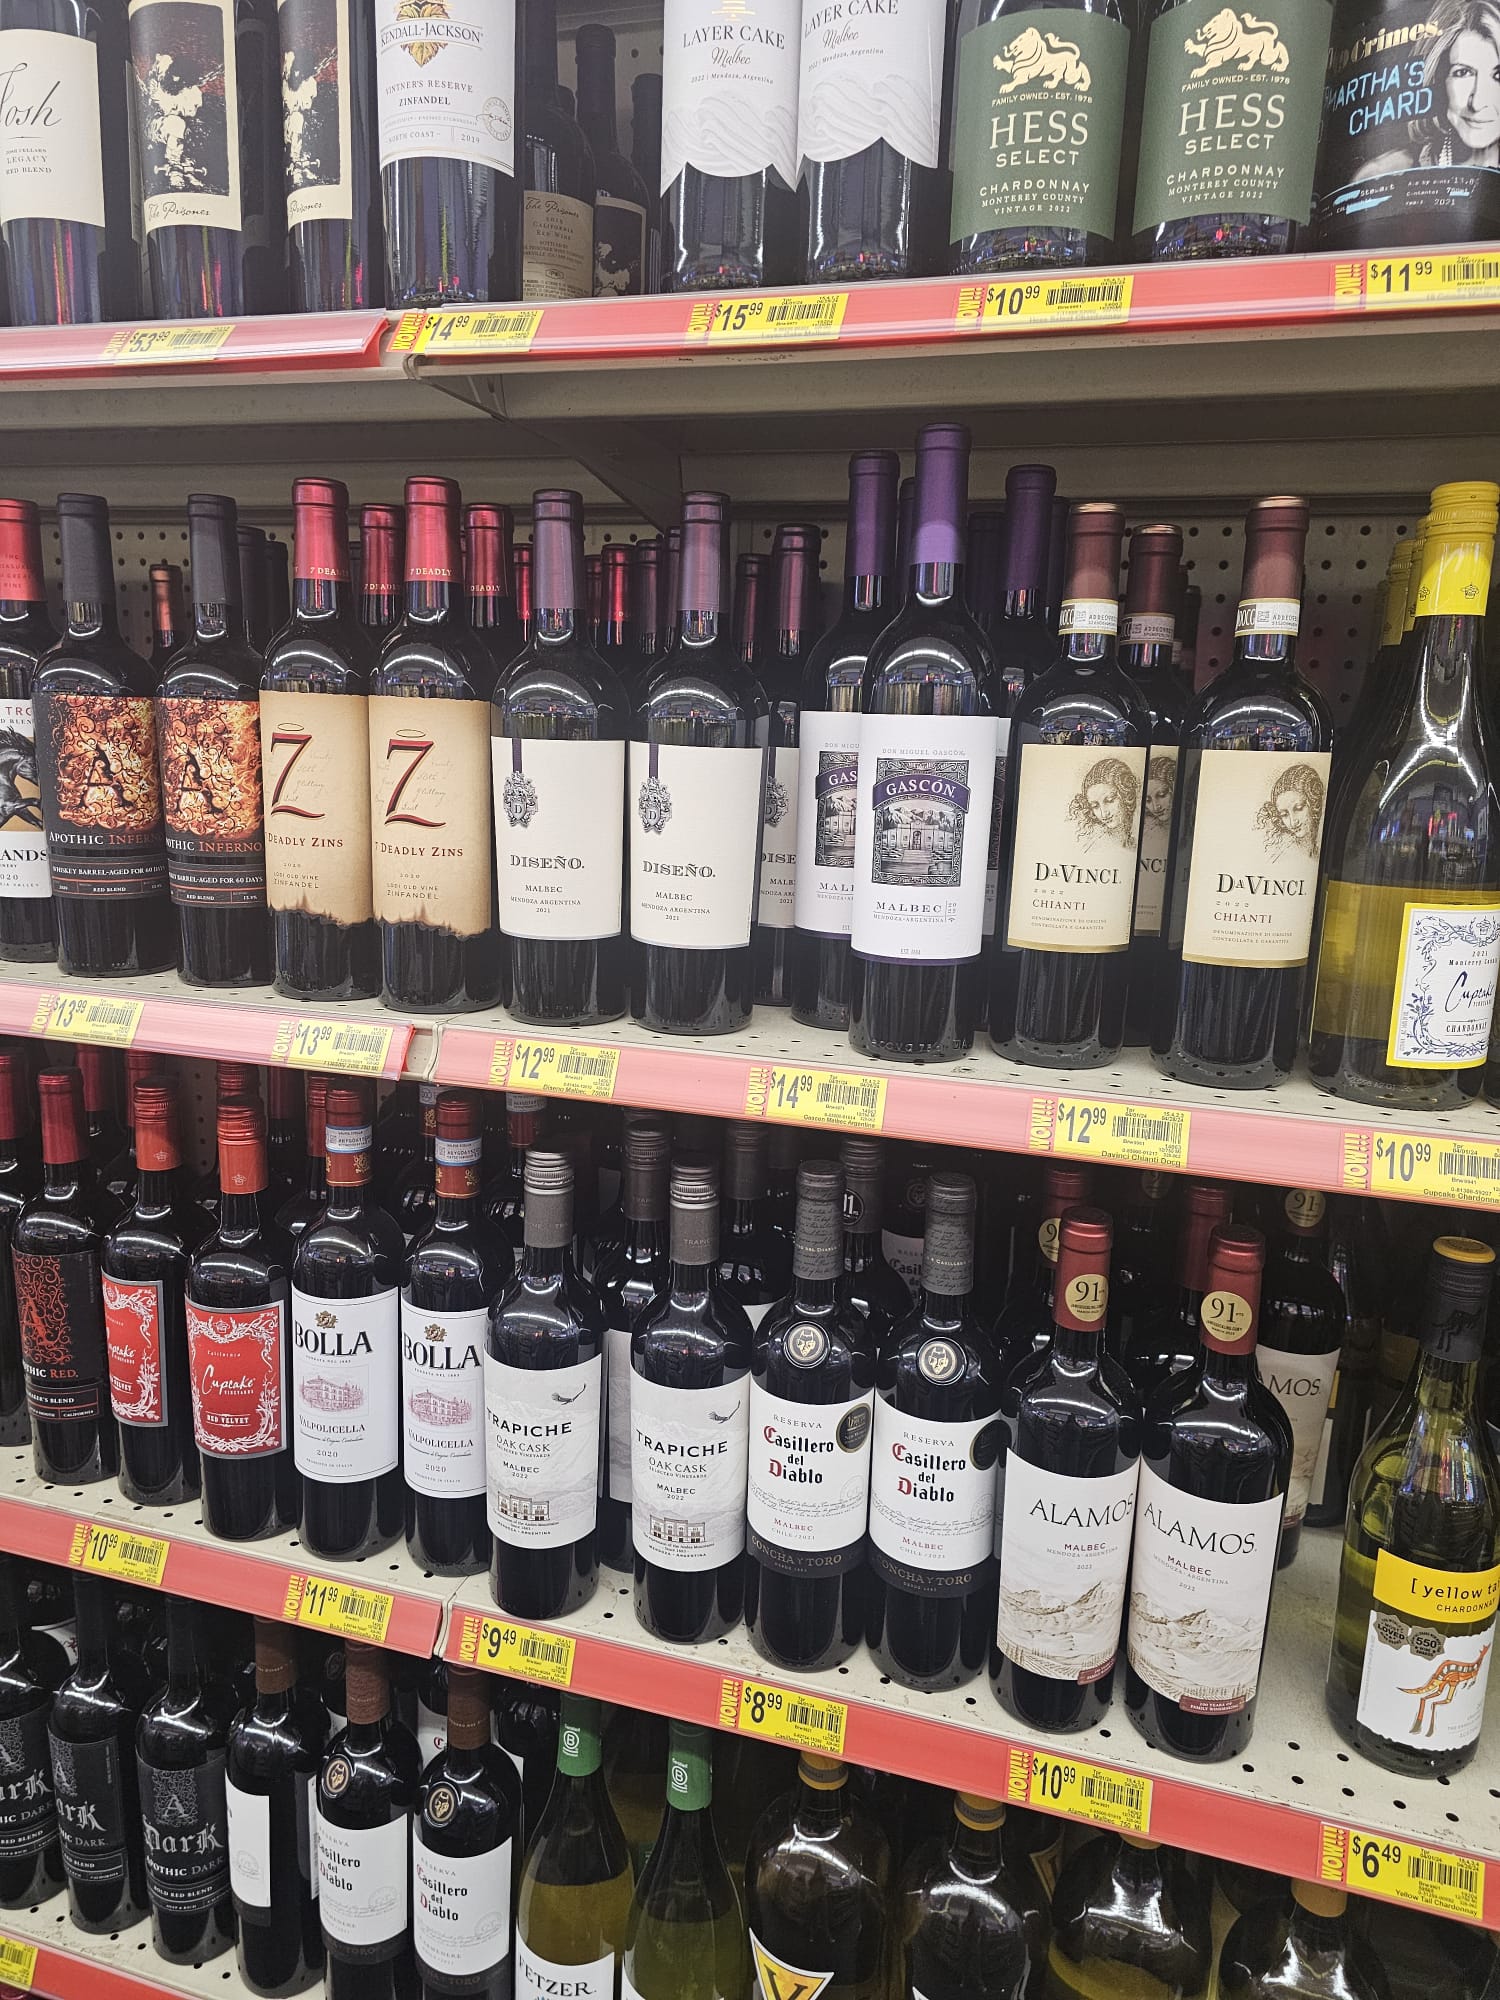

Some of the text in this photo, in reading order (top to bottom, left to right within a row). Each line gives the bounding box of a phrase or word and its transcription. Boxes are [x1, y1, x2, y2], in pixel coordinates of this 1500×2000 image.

[804, 4, 842, 39] LAYER
[380, 21, 480, 47] KENDALL-JACKSON
[683, 24, 785, 49] LAYER CAKE
[711, 44, 751, 67] Malbec
[428, 79, 473, 93] RESERVE
[1182, 80, 1210, 93] FAMILY
[1212, 76, 1243, 84] OWNED
[399, 96, 450, 106] ZINFANDEL
[991, 96, 1017, 107] FAMILY
[1019, 92, 1049, 101] OWNED
[1178, 92, 1285, 137] HESS
[1350, 87, 1432, 136] CHARD
[989, 110, 1088, 150] HESS
[1184, 133, 1275, 156] SELECT
[995, 150, 1079, 168] SELECT
[1166, 164, 1285, 186] CHARDONNAY
[979, 179, 1090, 197] CHARDONNAY
[1233, 178, 1279, 189] COUNTY
[981, 192, 1085, 208] MONTEREY COUNTY
[994, 204, 1043, 216] VINTAGE
[50, 832, 104, 845] APOTHIC
[268, 833, 344, 848] DEADLY ZINS
[200, 842, 262, 853] INFERNO
[381, 843, 464, 857] DEADLY ZINS
[386, 890, 439, 900] ZINFANDEL
[525, 884, 563, 893] MALBEC
[655, 891, 693, 902] MALBEC
[876, 901, 943, 913] MALBEC
[1032, 899, 1086, 911] CHIANTI
[1213, 912, 1272, 924] CHIANTI
[1101, 1150, 1130, 1159] Davinci
[1131, 1154, 1159, 1163] Chianti
[1423, 1188, 1456, 1199] Cupcake
[1075, 1281, 1101, 1302] 91
[1210, 1298, 1236, 1324] 91
[295, 1320, 373, 1356] BOLLA
[404, 1332, 481, 1369] BOLLA
[201, 1364, 255, 1395] Cupcake
[299, 1415, 366, 1434] VALPOLICELLA
[487, 1407, 572, 1437] TRAPICHE
[773, 1414, 823, 1429] RESERVA
[408, 1428, 474, 1448] VALPOLICELLA
[496, 1434, 551, 1452] OAK CASK
[636, 1429, 728, 1458] TRAPICHE
[763, 1425, 834, 1453] Casillero
[903, 1431, 955, 1447] RESERVA
[316, 1450, 338, 1458] 2020
[787, 1454, 804, 1466] del
[891, 1442, 966, 1471] Casillero
[425, 1464, 447, 1472] 2020
[503, 1460, 540, 1473] MALBEC
[648, 1456, 708, 1473] OAK CASK
[769, 1458, 823, 1484] Diablo
[918, 1472, 935, 1484] del
[656, 1483, 697, 1495] MALBEC
[897, 1476, 955, 1502] Diablo
[1030, 1492, 1134, 1528] ALAMOS
[773, 1517, 814, 1532] MALBEC
[1143, 1502, 1256, 1555] ALAMOS
[751, 1535, 842, 1566] CONCHA TORO
[902, 1536, 943, 1551] MALBEC
[1064, 1542, 1106, 1552] MALBEC
[1167, 1554, 1212, 1576] MALBEC
[935, 1573, 972, 1586] TORO
[1422, 1585, 1483, 1600] yellow
[1436, 1598, 1496, 1613] CHARDONNAY
[1377, 1623, 1405, 1640] LOVED
[1415, 1636, 1437, 1648] 550
[327, 1863, 338, 1873] del
[320, 1863, 353, 1891] Diablo
[416, 1864, 468, 1897] Casillero
[188, 1886, 213, 1898] BLEND
[431, 1893, 443, 1904] del
[420, 1892, 459, 1921] Diablo
[1395, 1889, 1478, 1916] Yellow Tail Chardonnay
